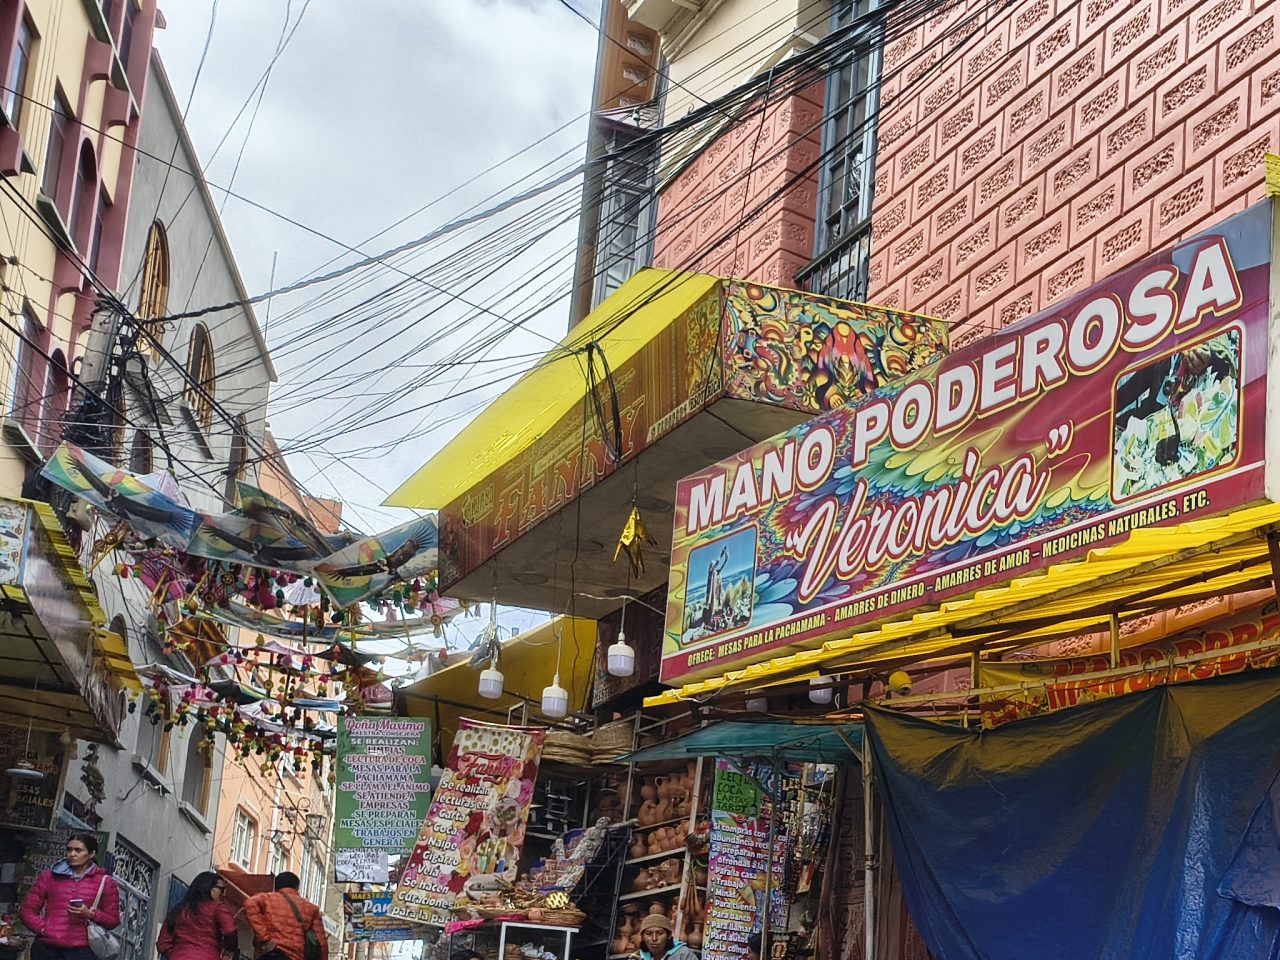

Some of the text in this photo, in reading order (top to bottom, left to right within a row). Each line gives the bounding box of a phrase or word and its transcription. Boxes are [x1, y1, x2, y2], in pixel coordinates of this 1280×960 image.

[685, 423, 836, 537] MANO
[852, 235, 1244, 467] PODEROSA
[784, 418, 1074, 604] “Veronica”
[688, 490, 1210, 667] OFRECE: MESAS PARA LA PACHAMAMA AMARRES DE DINERO AMARRES DE AMOR MEDICINAS NATURALES, ETC.
[345, 719, 424, 732] Doña Maxima
[389, 755, 426, 764] DE COCA
[384, 764, 421, 773] PARA LA
[355, 774, 414, 782] PACHAMAMA
[441, 780, 491, 795] Se realizan
[717, 783, 742, 794] COCA
[370, 792, 415, 800] ATIENDE A
[360, 801, 409, 809] EMPRESAS
[437, 795, 475, 809] lecturas
[717, 801, 748, 812] TAROT
[368, 811, 416, 819] PREPARAN
[439, 809, 466, 821] Carta
[340, 820, 371, 828] MESAS
[434, 823, 458, 835] Coca
[403, 829, 416, 837] EN
[754, 829, 767, 838] con
[428, 837, 457, 850] Naipe
[723, 846, 755, 859] preparan
[423, 851, 459, 866] Cigarro
[417, 864, 439, 878] Vela
[741, 870, 757, 879] casa
[404, 877, 449, 894] Se hacen
[716, 878, 744, 888] Trabajo
[715, 888, 736, 898] Minas
[398, 891, 455, 909] Curaciones
[392, 906, 429, 920] para la
[730, 912, 751, 922] banco
[728, 934, 748, 943] autos
